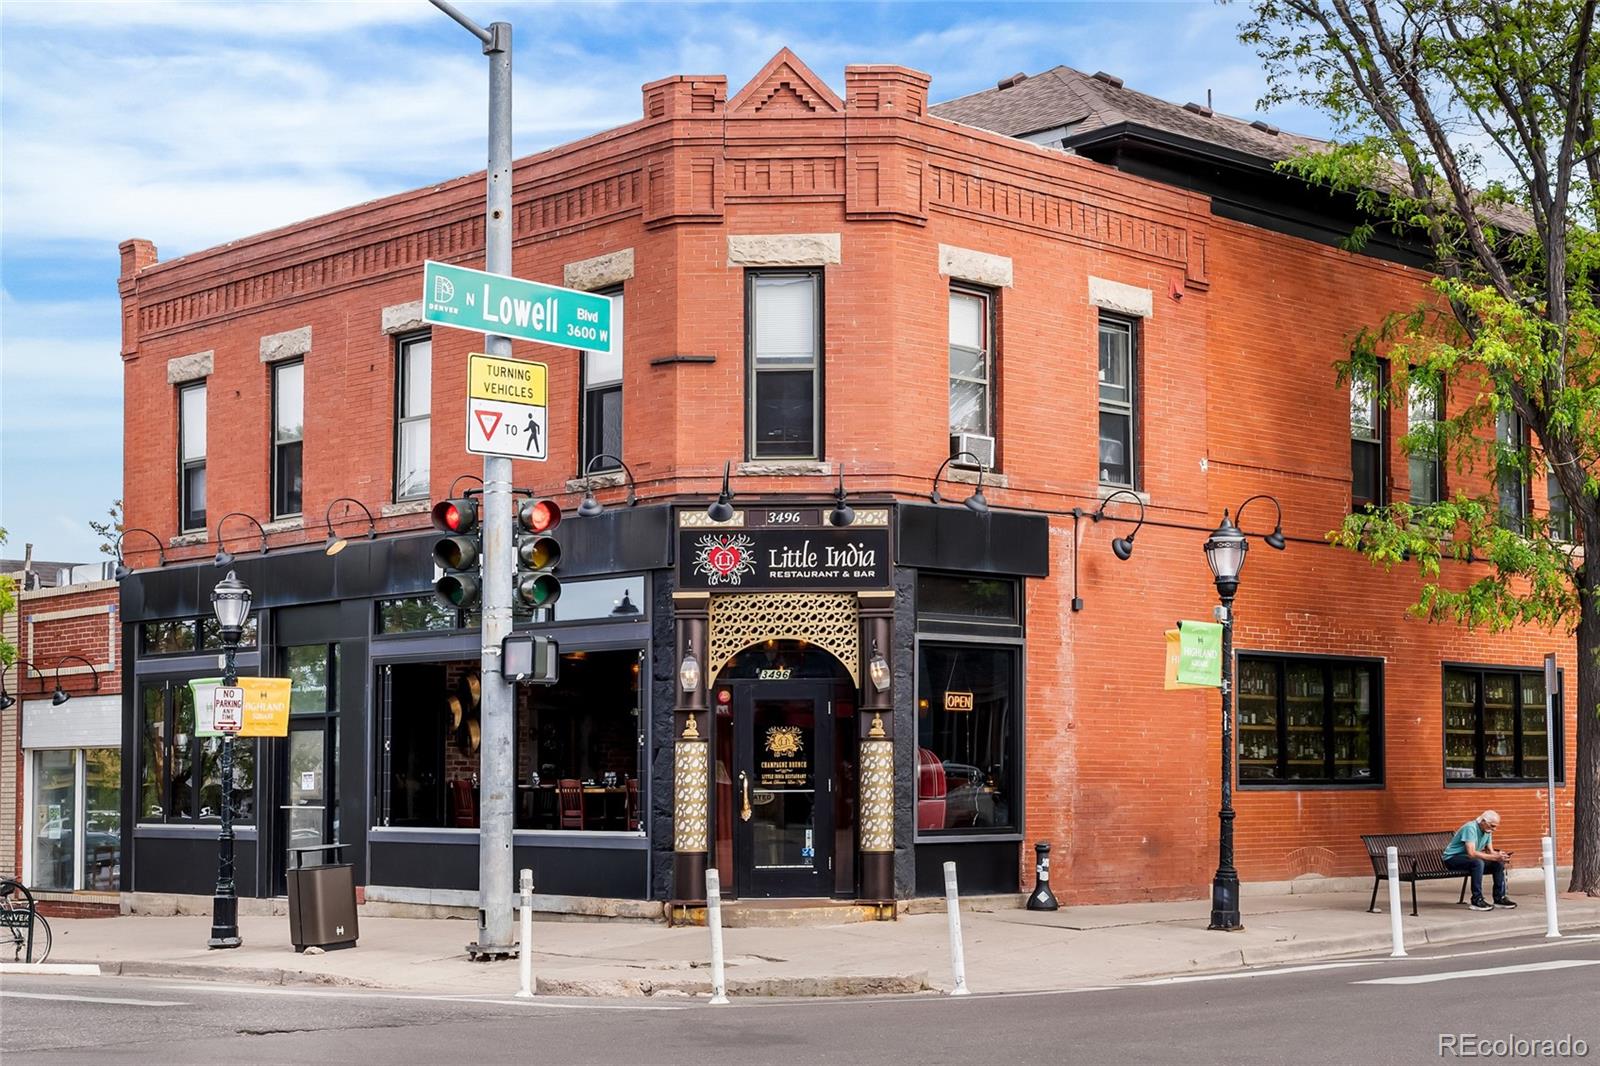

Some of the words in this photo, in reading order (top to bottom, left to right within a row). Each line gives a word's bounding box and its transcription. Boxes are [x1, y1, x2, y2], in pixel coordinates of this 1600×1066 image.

[428, 303, 458, 314] DENVER
[466, 292, 475, 306] N
[483, 283, 558, 333] Lowell
[577, 307, 599, 323] Blvd
[567, 323, 597, 340] 3600
[599, 329, 608, 342] W
[487, 364, 531, 381] TURNING
[483, 382, 534, 399] VEHICLES
[505, 424, 518, 436] TO
[767, 512, 801, 523] 3496
[768, 540, 818, 568] Little
[825, 542, 876, 567] India
[769, 570, 839, 578] RESTAURANT
[842, 570, 850, 578] &
[853, 570, 875, 578] BAR
[761, 670, 790, 679] 3496
[223, 690, 235, 698] NO
[215, 699, 241, 708] PARKING
[948, 695, 971, 708] OPEN
[0, 913, 30, 921] ENVER
